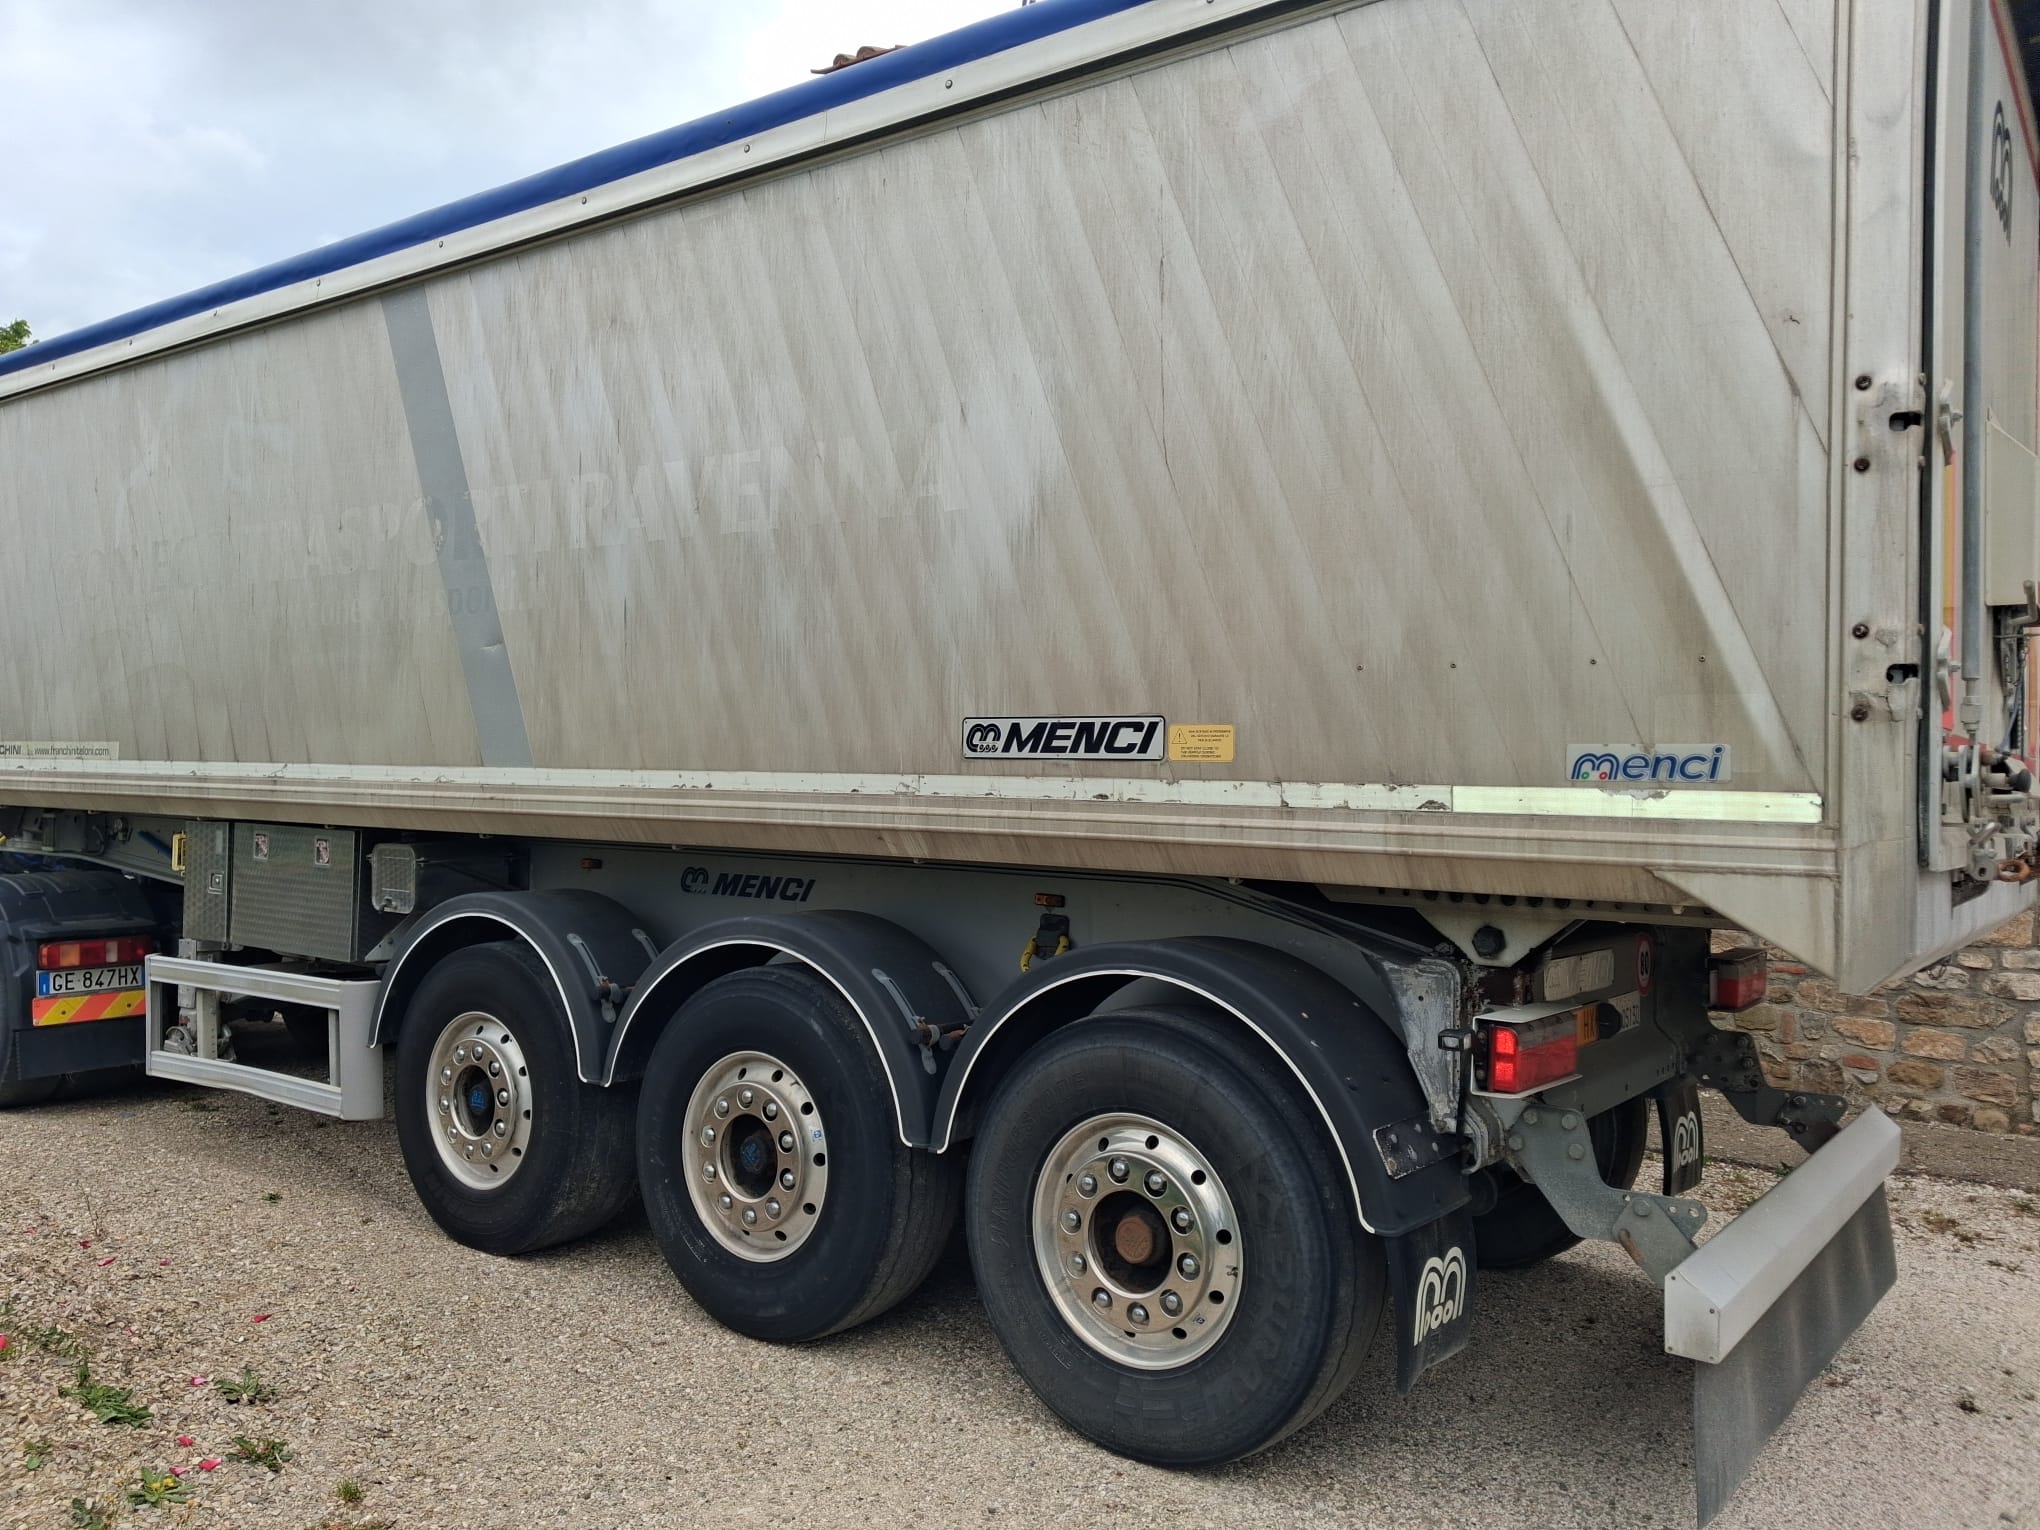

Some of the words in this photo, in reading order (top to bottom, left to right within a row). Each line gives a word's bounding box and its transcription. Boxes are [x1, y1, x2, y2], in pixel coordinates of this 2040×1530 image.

[0, 744, 22, 756] CHINI
[1000, 721, 1160, 755] MENCI
[1570, 744, 1726, 782] menci
[711, 872, 817, 902] MENCI
[1640, 951, 1649, 976] 80
[52, 972, 75, 991] GE
[82, 967, 139, 989] 847HX
